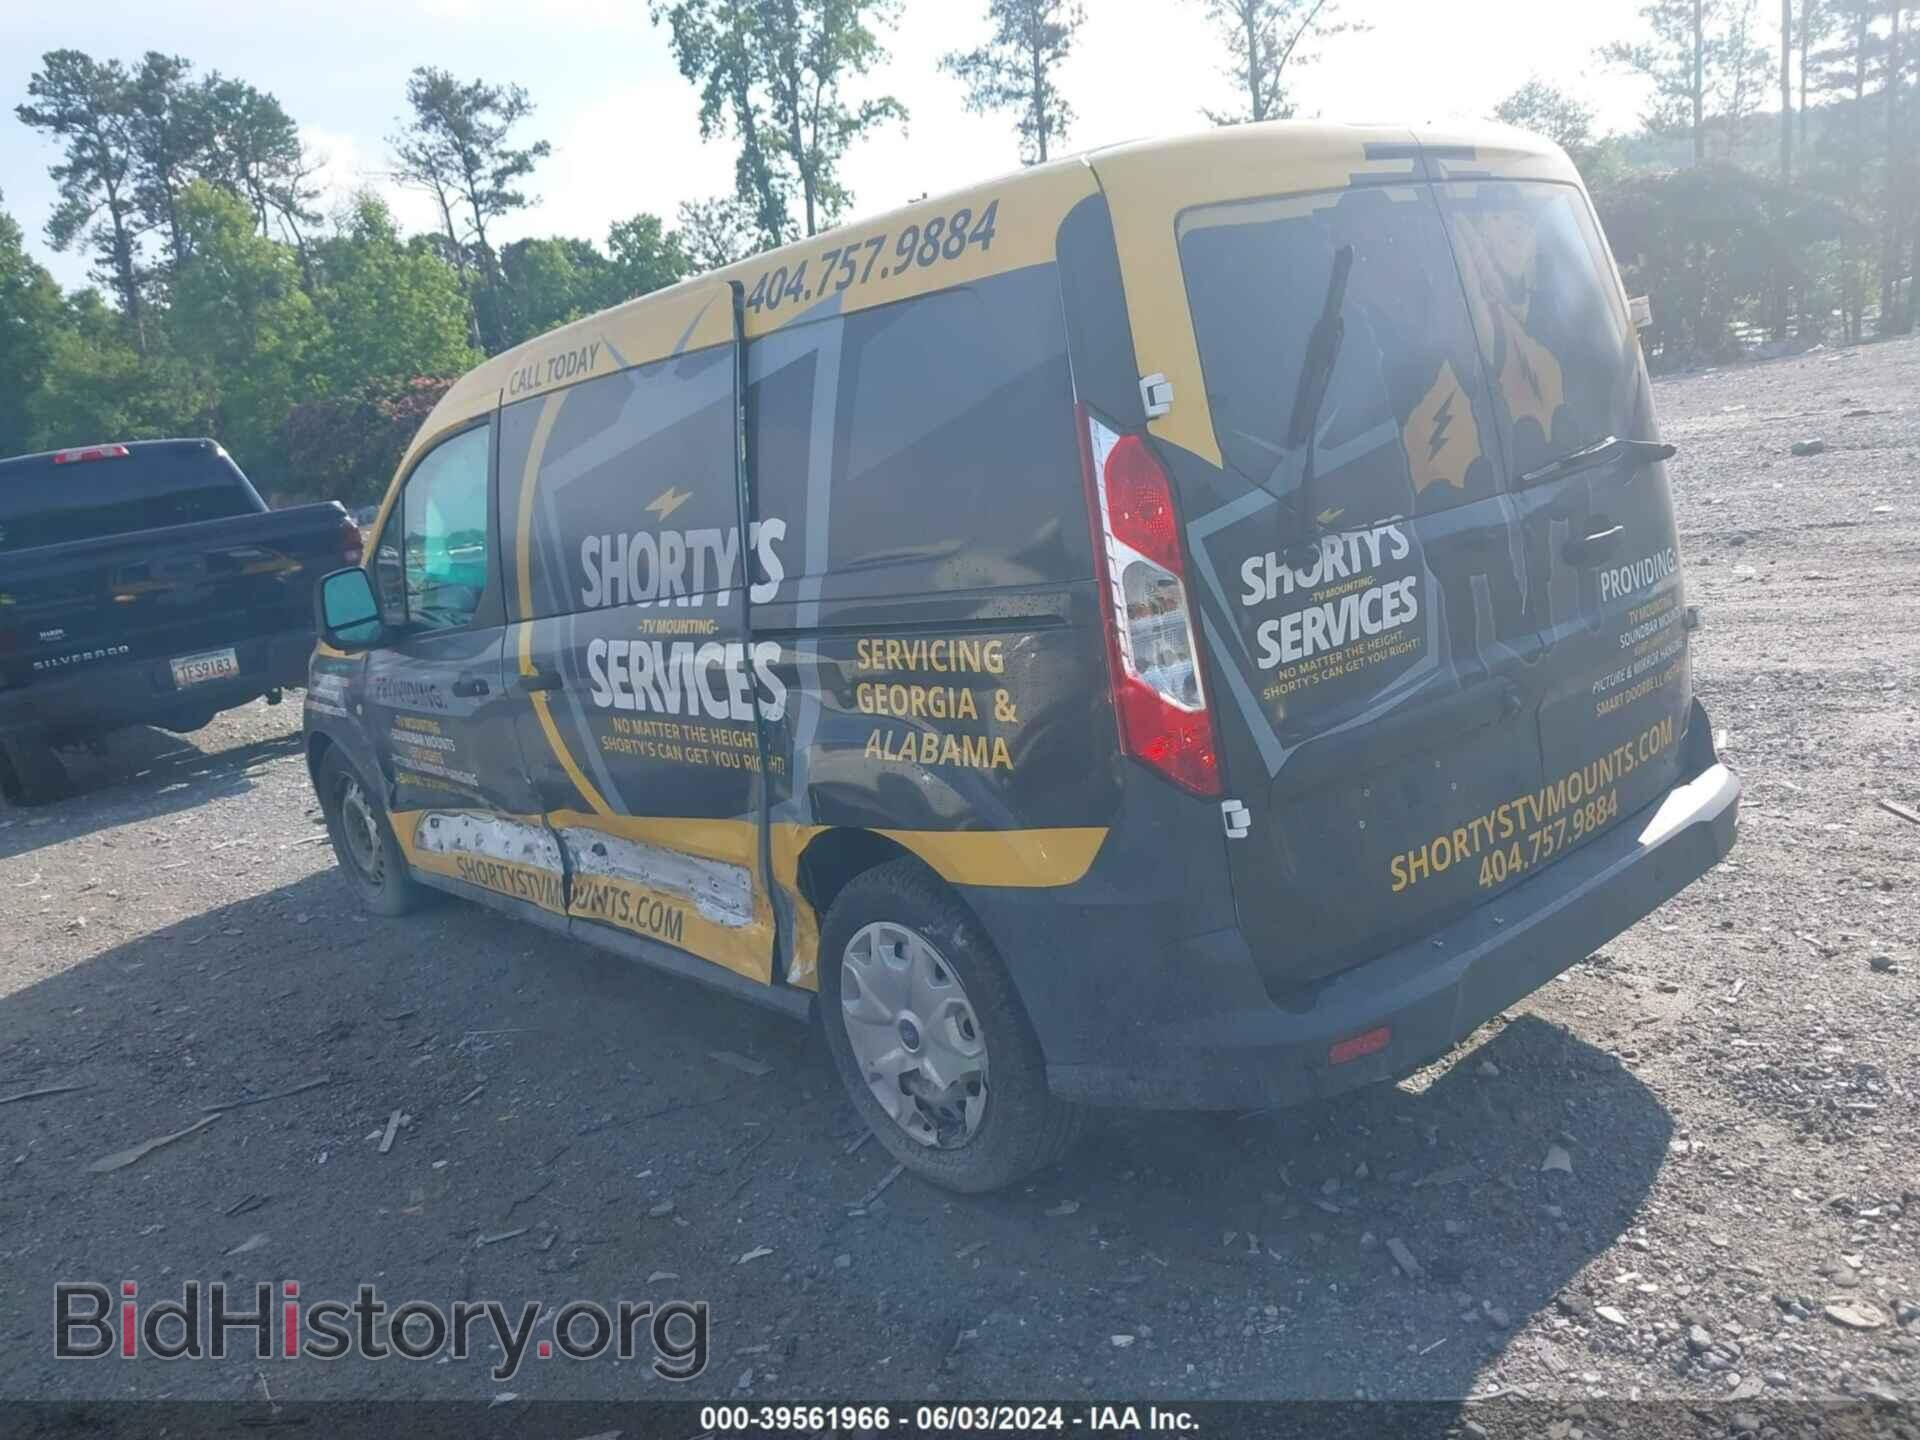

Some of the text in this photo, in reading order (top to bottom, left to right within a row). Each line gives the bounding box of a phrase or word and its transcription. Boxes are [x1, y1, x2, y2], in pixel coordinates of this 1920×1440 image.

[746, 200, 999, 314] 404.757.9884
[511, 342, 601, 395] CALL TODAY
[1257, 576, 1418, 669] SERVICES
[33, 645, 128, 670] SILVERADO
[856, 639, 1005, 674] SERVICING
[1263, 673, 1319, 700] SHORTY'S
[1321, 664, 1344, 681] CAN
[1345, 656, 1365, 672] GET
[1367, 650, 1390, 664] YOU
[1279, 667, 1296, 681] NO
[1299, 651, 1343, 674] MATTER
[1345, 642, 1366, 657] THE
[587, 638, 787, 722] SERVICES
[856, 683, 1018, 722] GEORGIA &
[602, 736, 657, 757] SHORTY'S
[657, 743, 683, 760] CAN
[686, 747, 710, 764] GET
[712, 750, 740, 769] YOU
[612, 718, 630, 733] NO
[632, 719, 681, 740] MATTER
[681, 725, 710, 743] THE
[864, 728, 1014, 770] ALABAMA
[1391, 716, 1673, 892] SHORTYSTVMOUNTS.COM
[1479, 789, 1618, 888] 404.757.9884
